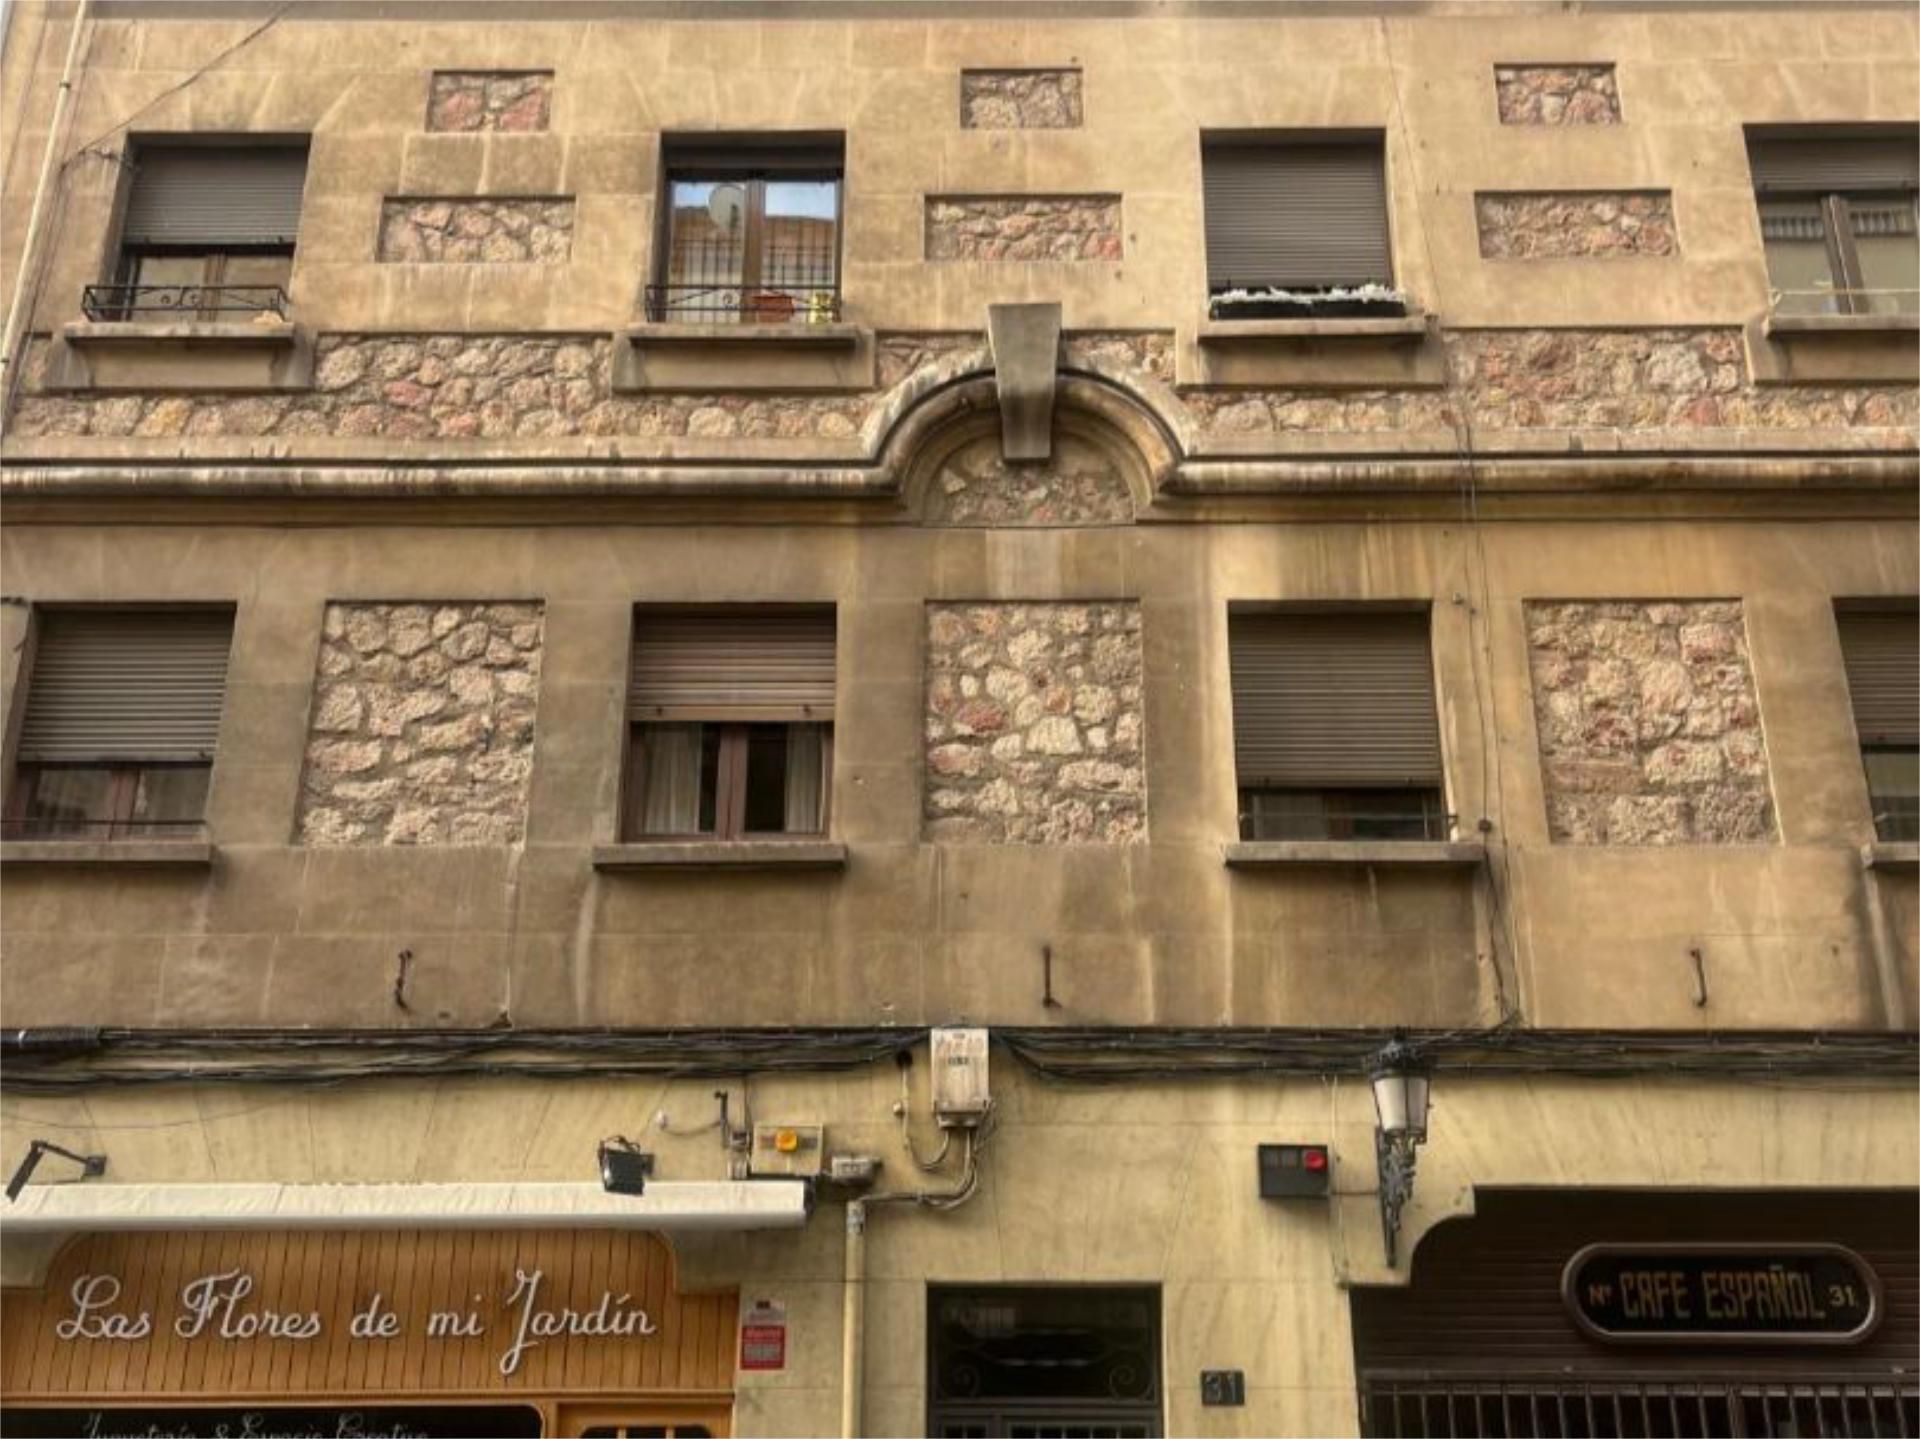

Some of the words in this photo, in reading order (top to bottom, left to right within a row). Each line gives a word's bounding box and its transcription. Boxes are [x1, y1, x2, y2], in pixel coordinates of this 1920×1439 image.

[1619, 1271, 1691, 1319] CAFE
[1701, 1264, 1826, 1319] ESPAÑOL
[1829, 1285, 1855, 1307] 31
[56, 1274, 152, 1339] Las
[174, 1268, 321, 1339] Flores
[350, 1293, 401, 1338] de
[426, 1294, 484, 1337] mi
[499, 1269, 656, 1375] Jardín
[1205, 1371, 1237, 1403] 31
